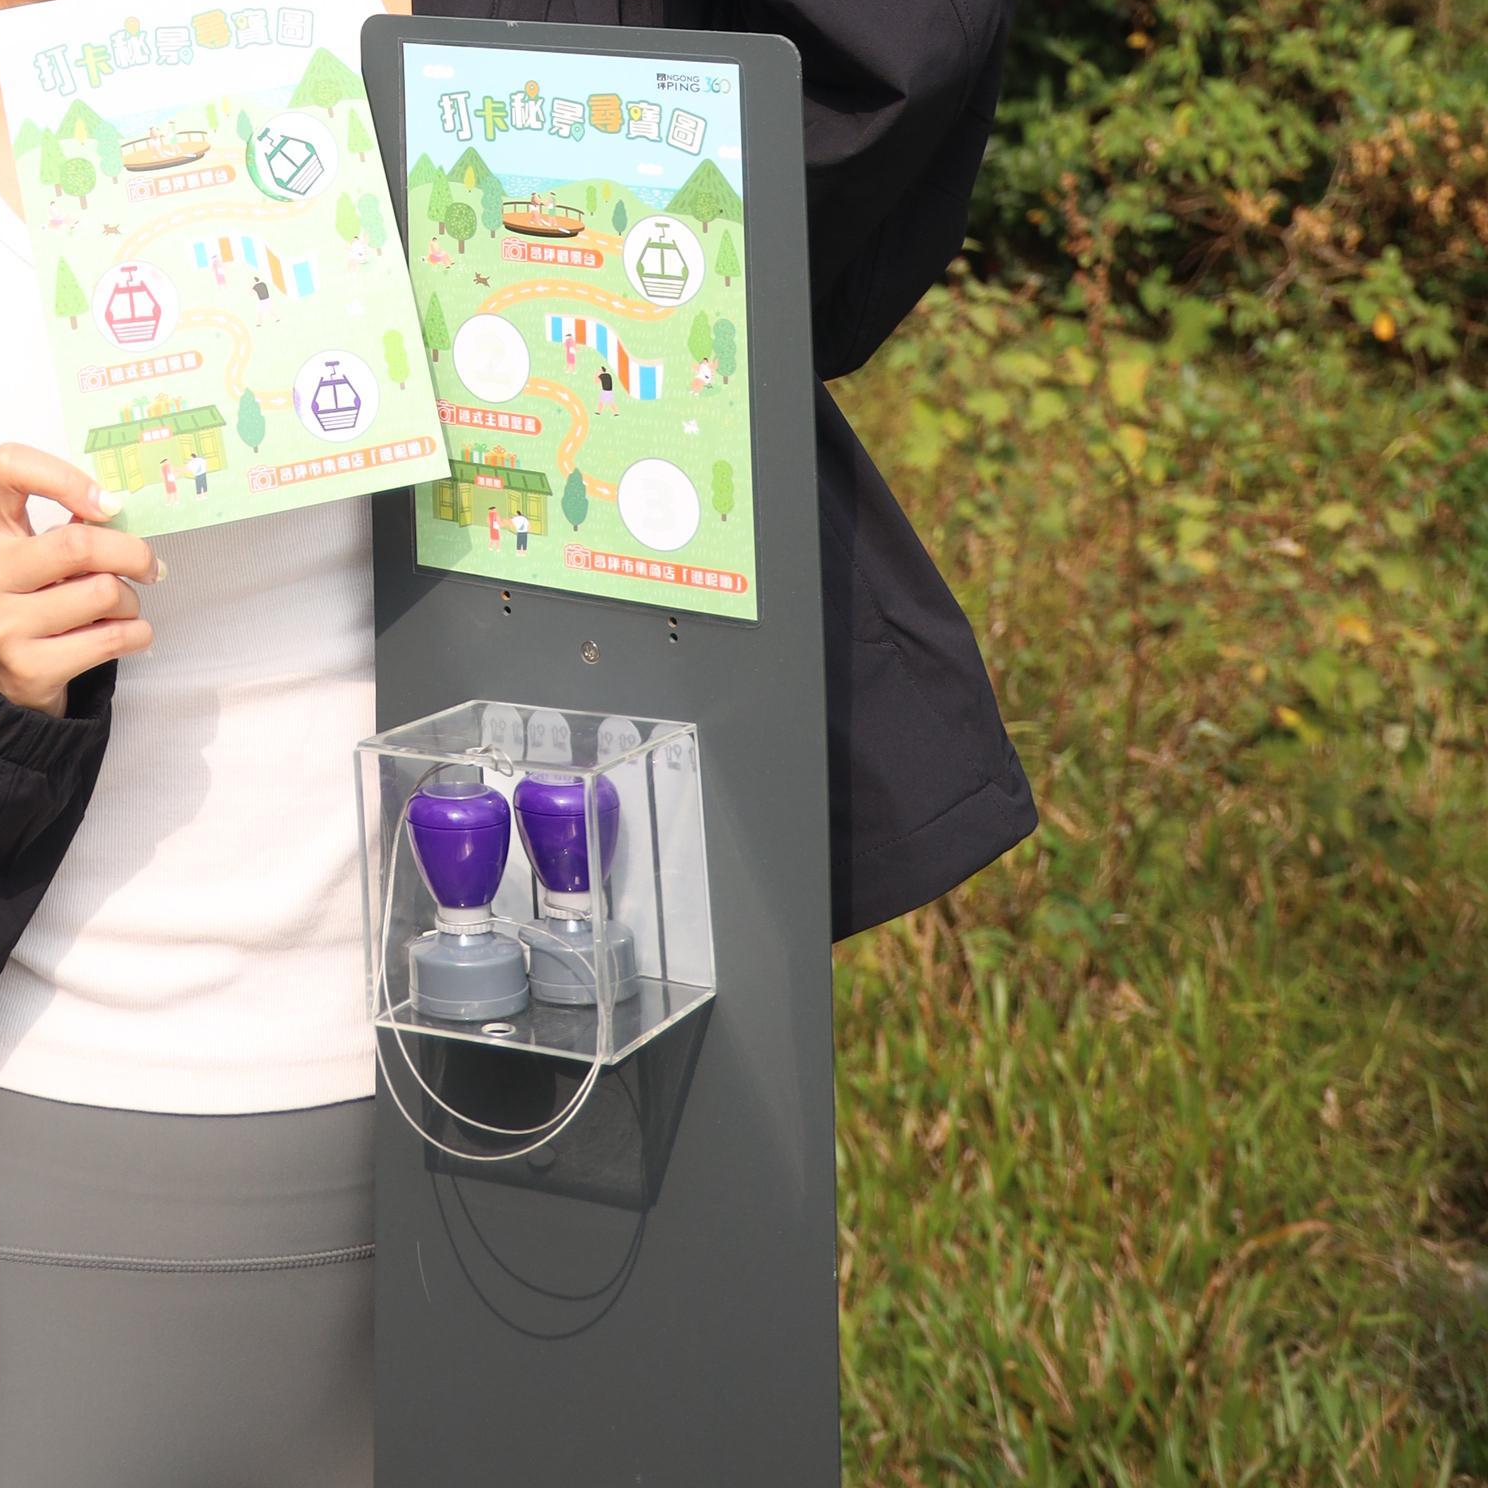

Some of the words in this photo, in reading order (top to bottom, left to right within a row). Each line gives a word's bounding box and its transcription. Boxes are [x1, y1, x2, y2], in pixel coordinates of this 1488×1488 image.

[666, 74, 700, 83] NGONG
[703, 75, 731, 94] 360
[666, 81, 701, 93] PING
[438, 89, 708, 156] 打卡秘景尋寶圖
